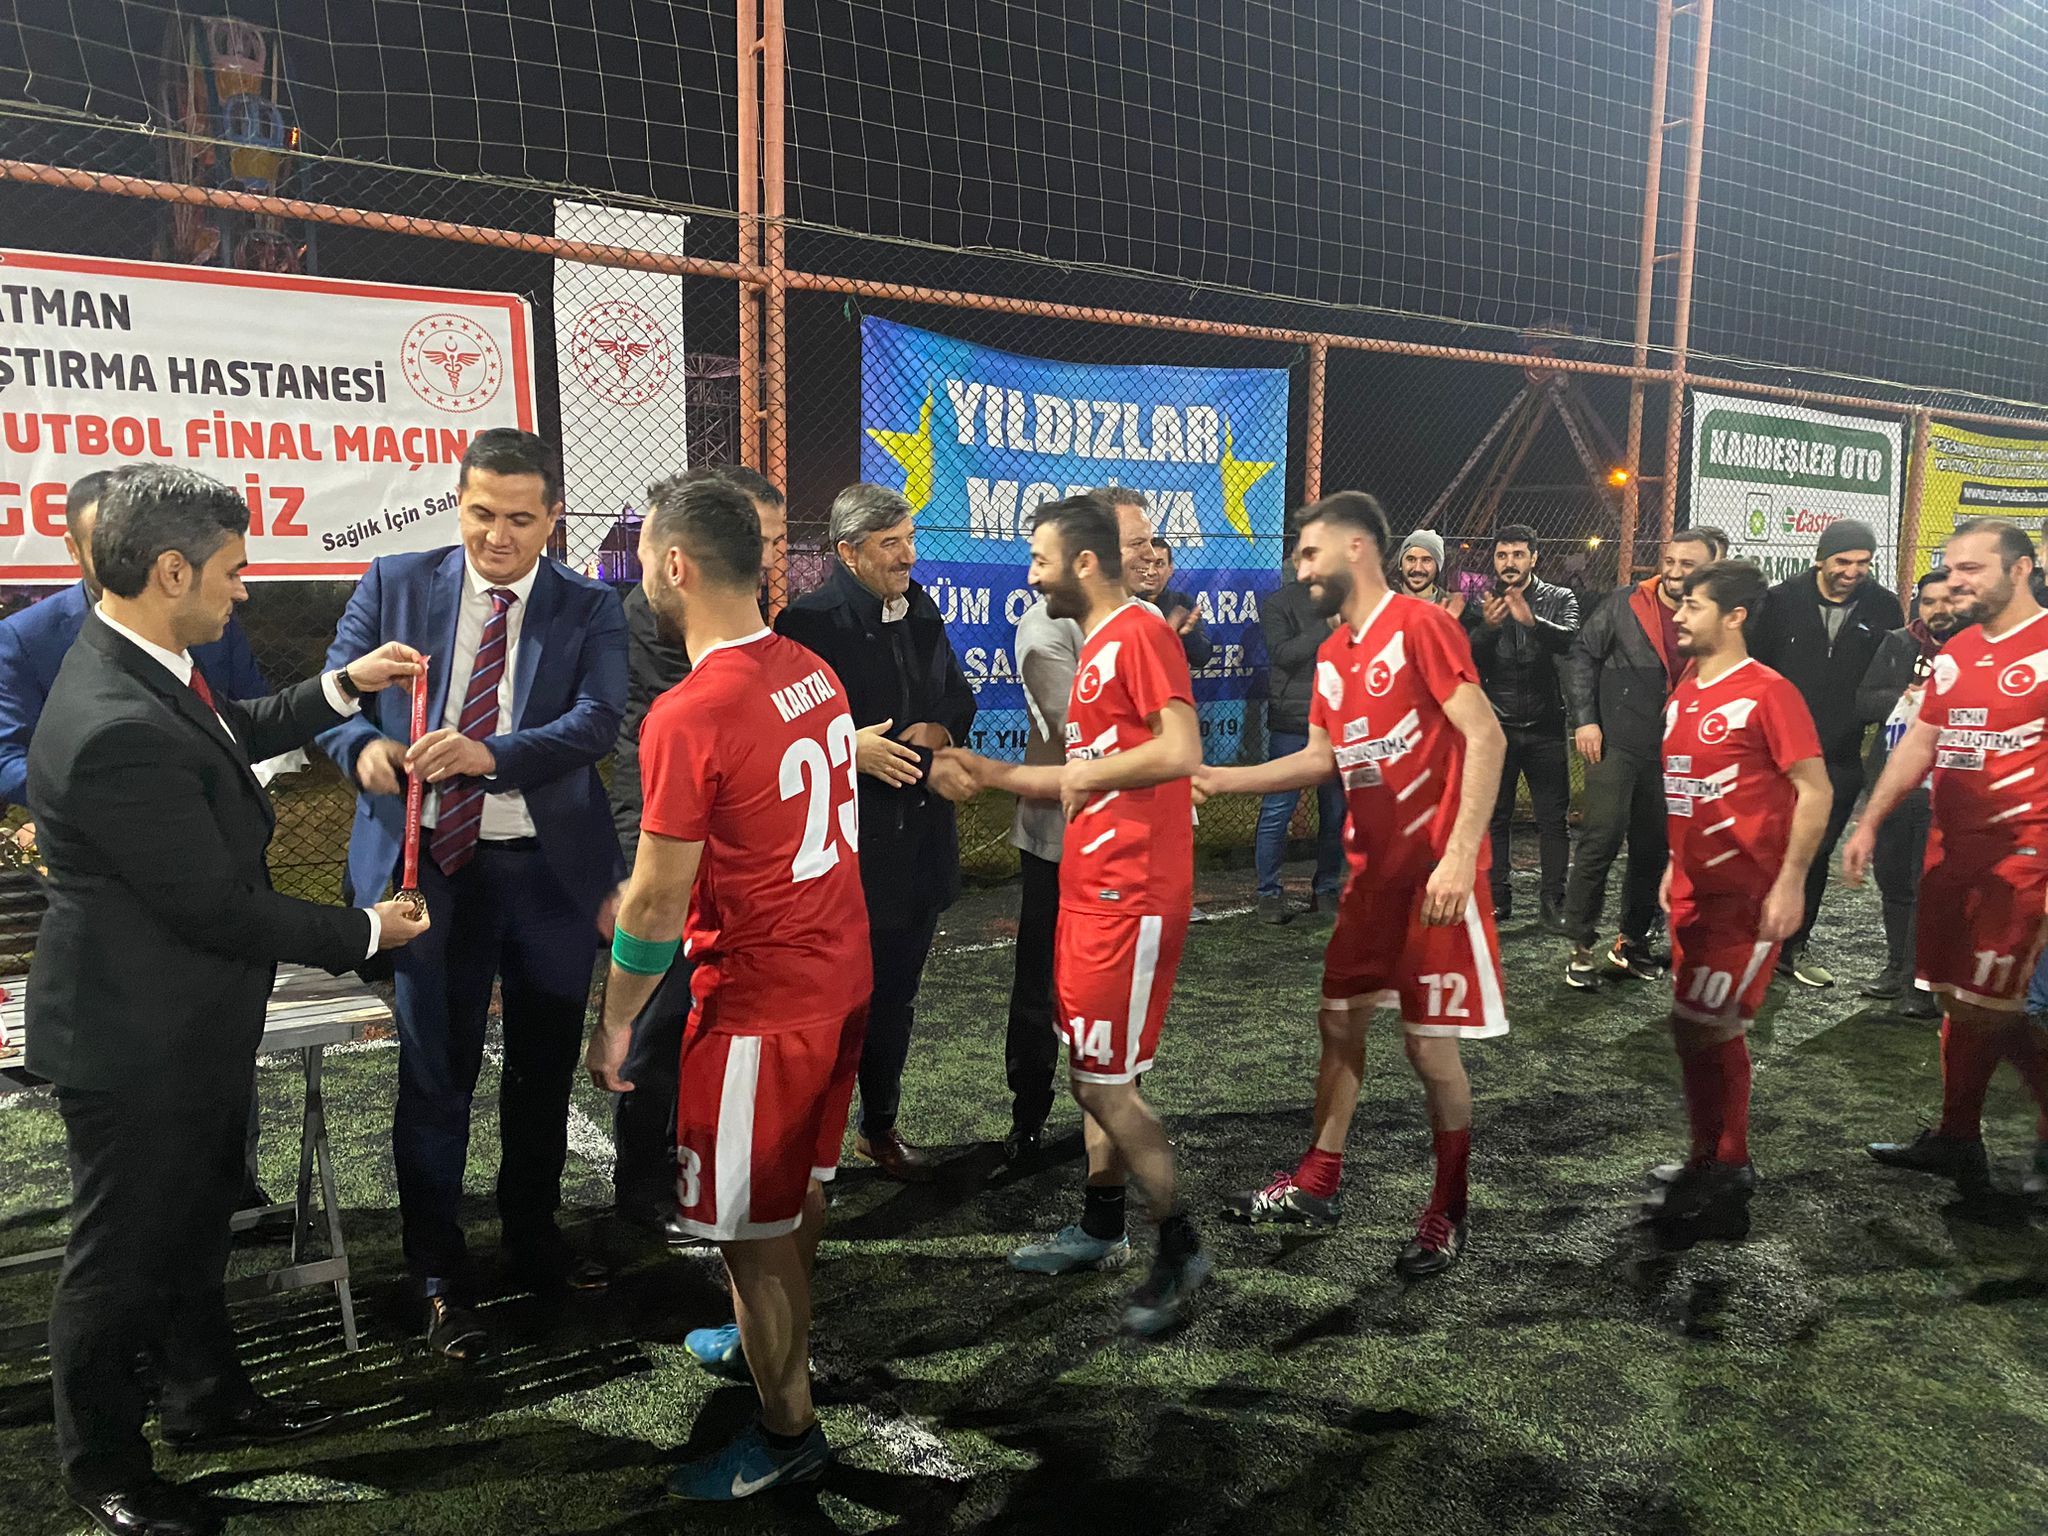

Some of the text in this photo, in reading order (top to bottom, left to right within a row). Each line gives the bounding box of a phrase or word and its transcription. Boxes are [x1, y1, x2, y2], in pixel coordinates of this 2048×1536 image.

[0, 284, 131, 330] TMAN
[168, 356, 386, 403] HASTANESİ
[186, 410, 322, 461] FİNAL
[333, 425, 488, 471] MAÇIN
[946, 378, 1219, 464] YILDIZLAR
[1709, 429, 1836, 479] KARDEŞLER
[1840, 446, 1882, 482] OTO
[322, 491, 458, 551] Sağlık İçin Sah
[921, 577, 990, 625] ÜM
[770, 669, 836, 723] KARTAL
[779, 713, 858, 883] 23
[1418, 972, 1470, 1017] 12
[1689, 966, 1732, 1008] 10
[1973, 950, 2016, 992] 11
[1069, 1016, 1114, 1066] 14
